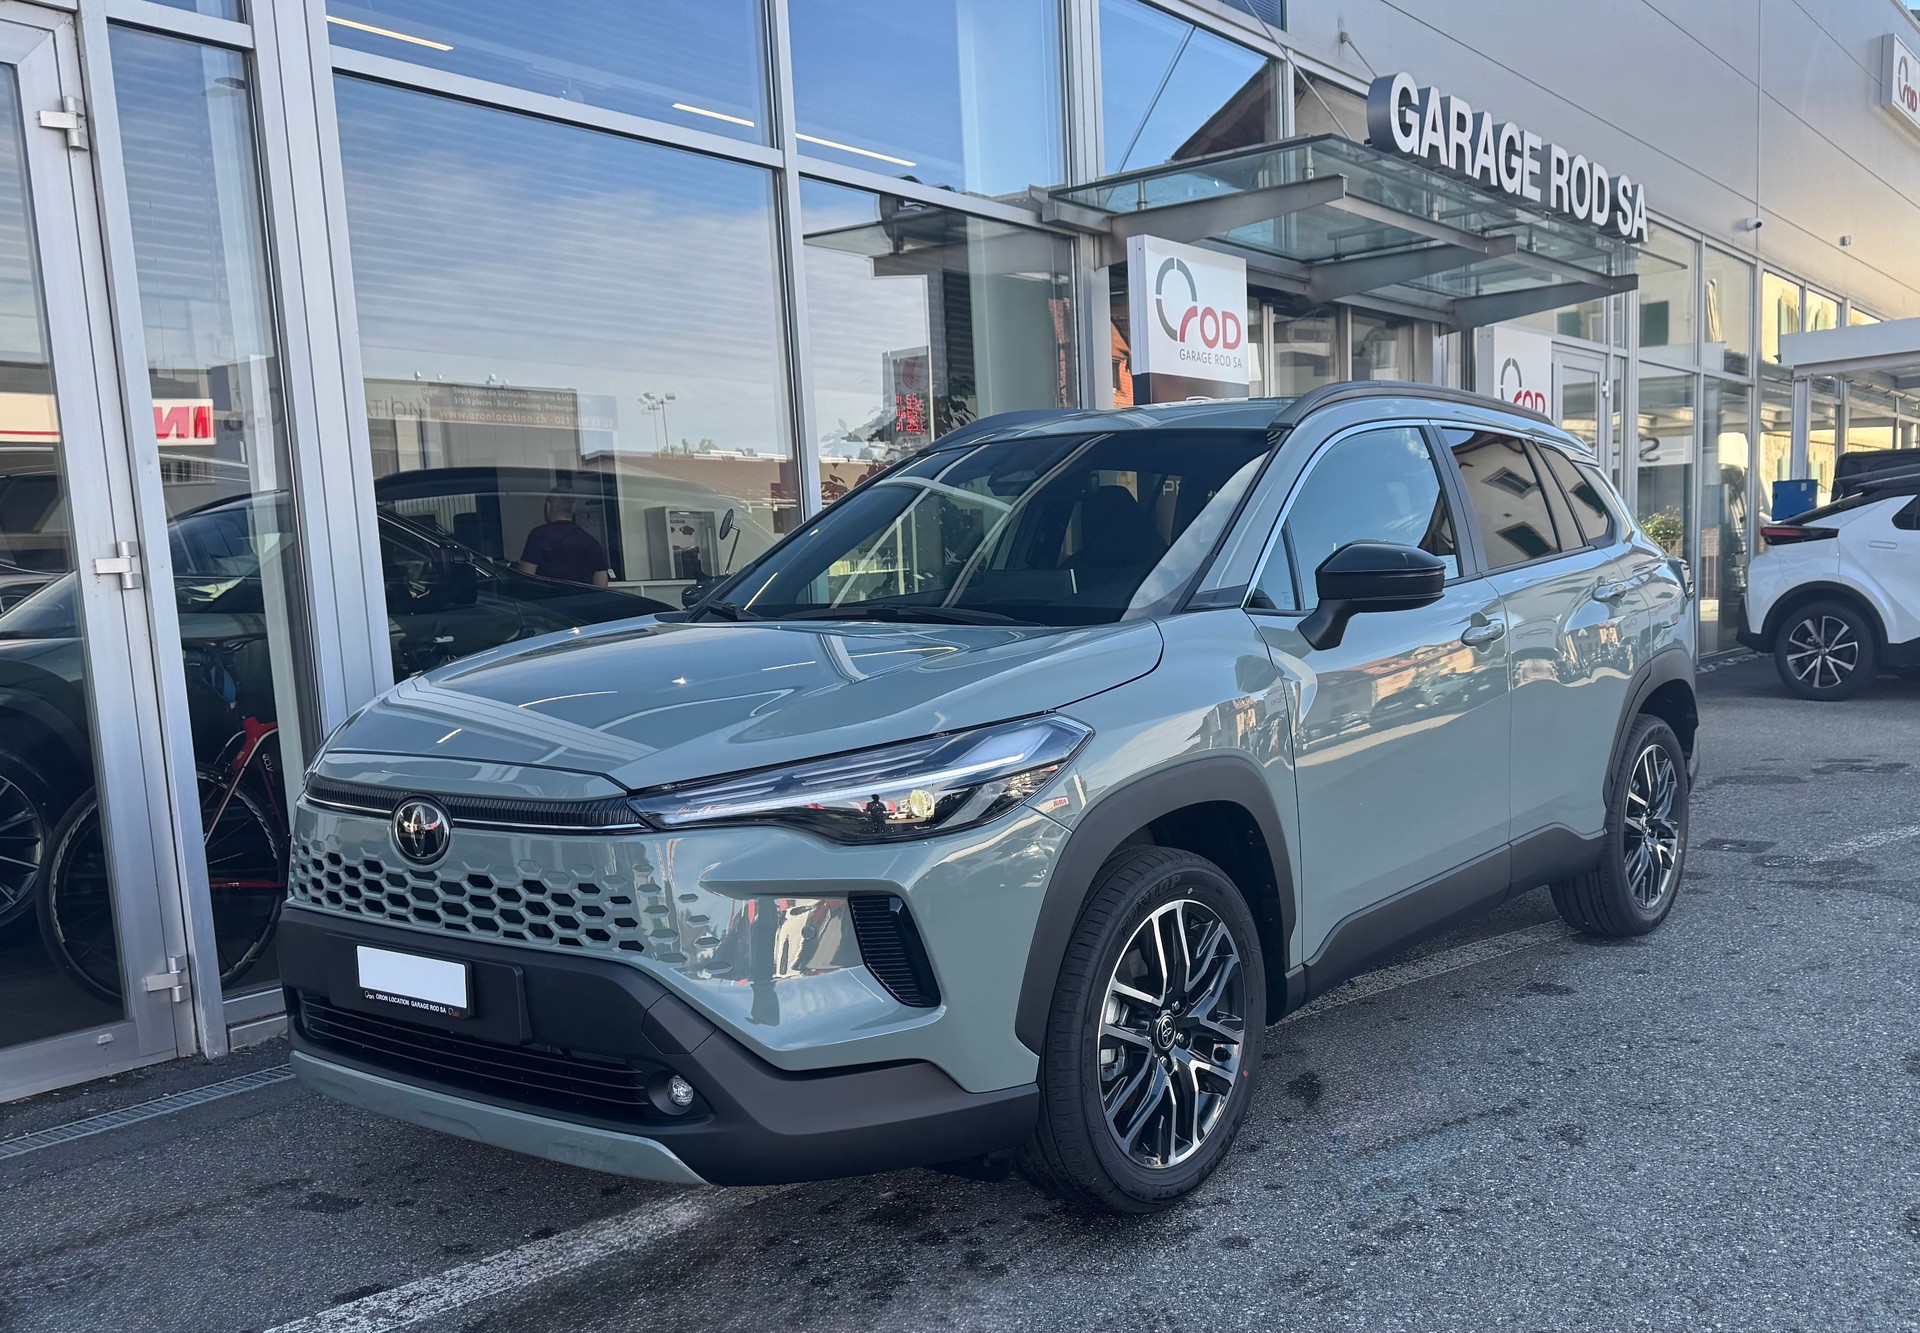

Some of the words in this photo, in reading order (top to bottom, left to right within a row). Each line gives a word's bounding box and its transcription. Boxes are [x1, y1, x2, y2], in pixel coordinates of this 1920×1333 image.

[1389, 72, 1542, 203] GARAGE
[1550, 143, 1611, 227] ROD
[1616, 174, 1649, 243] SA
[1179, 348, 1212, 365] GARAGE
[1214, 354, 1231, 367] ROD
[1233, 357, 1243, 369] SA
[439, 408, 547, 425] www.oronlocation.ch
[555, 416, 570, 425] 021
[1119, 873, 1182, 936] DUNLOP
[375, 993, 388, 1002] ORON
[388, 996, 410, 1006] LOCATION
[411, 1000, 430, 1011] GARAGE
[430, 1004, 439, 1012] ROD
[439, 1006, 447, 1014] SA
